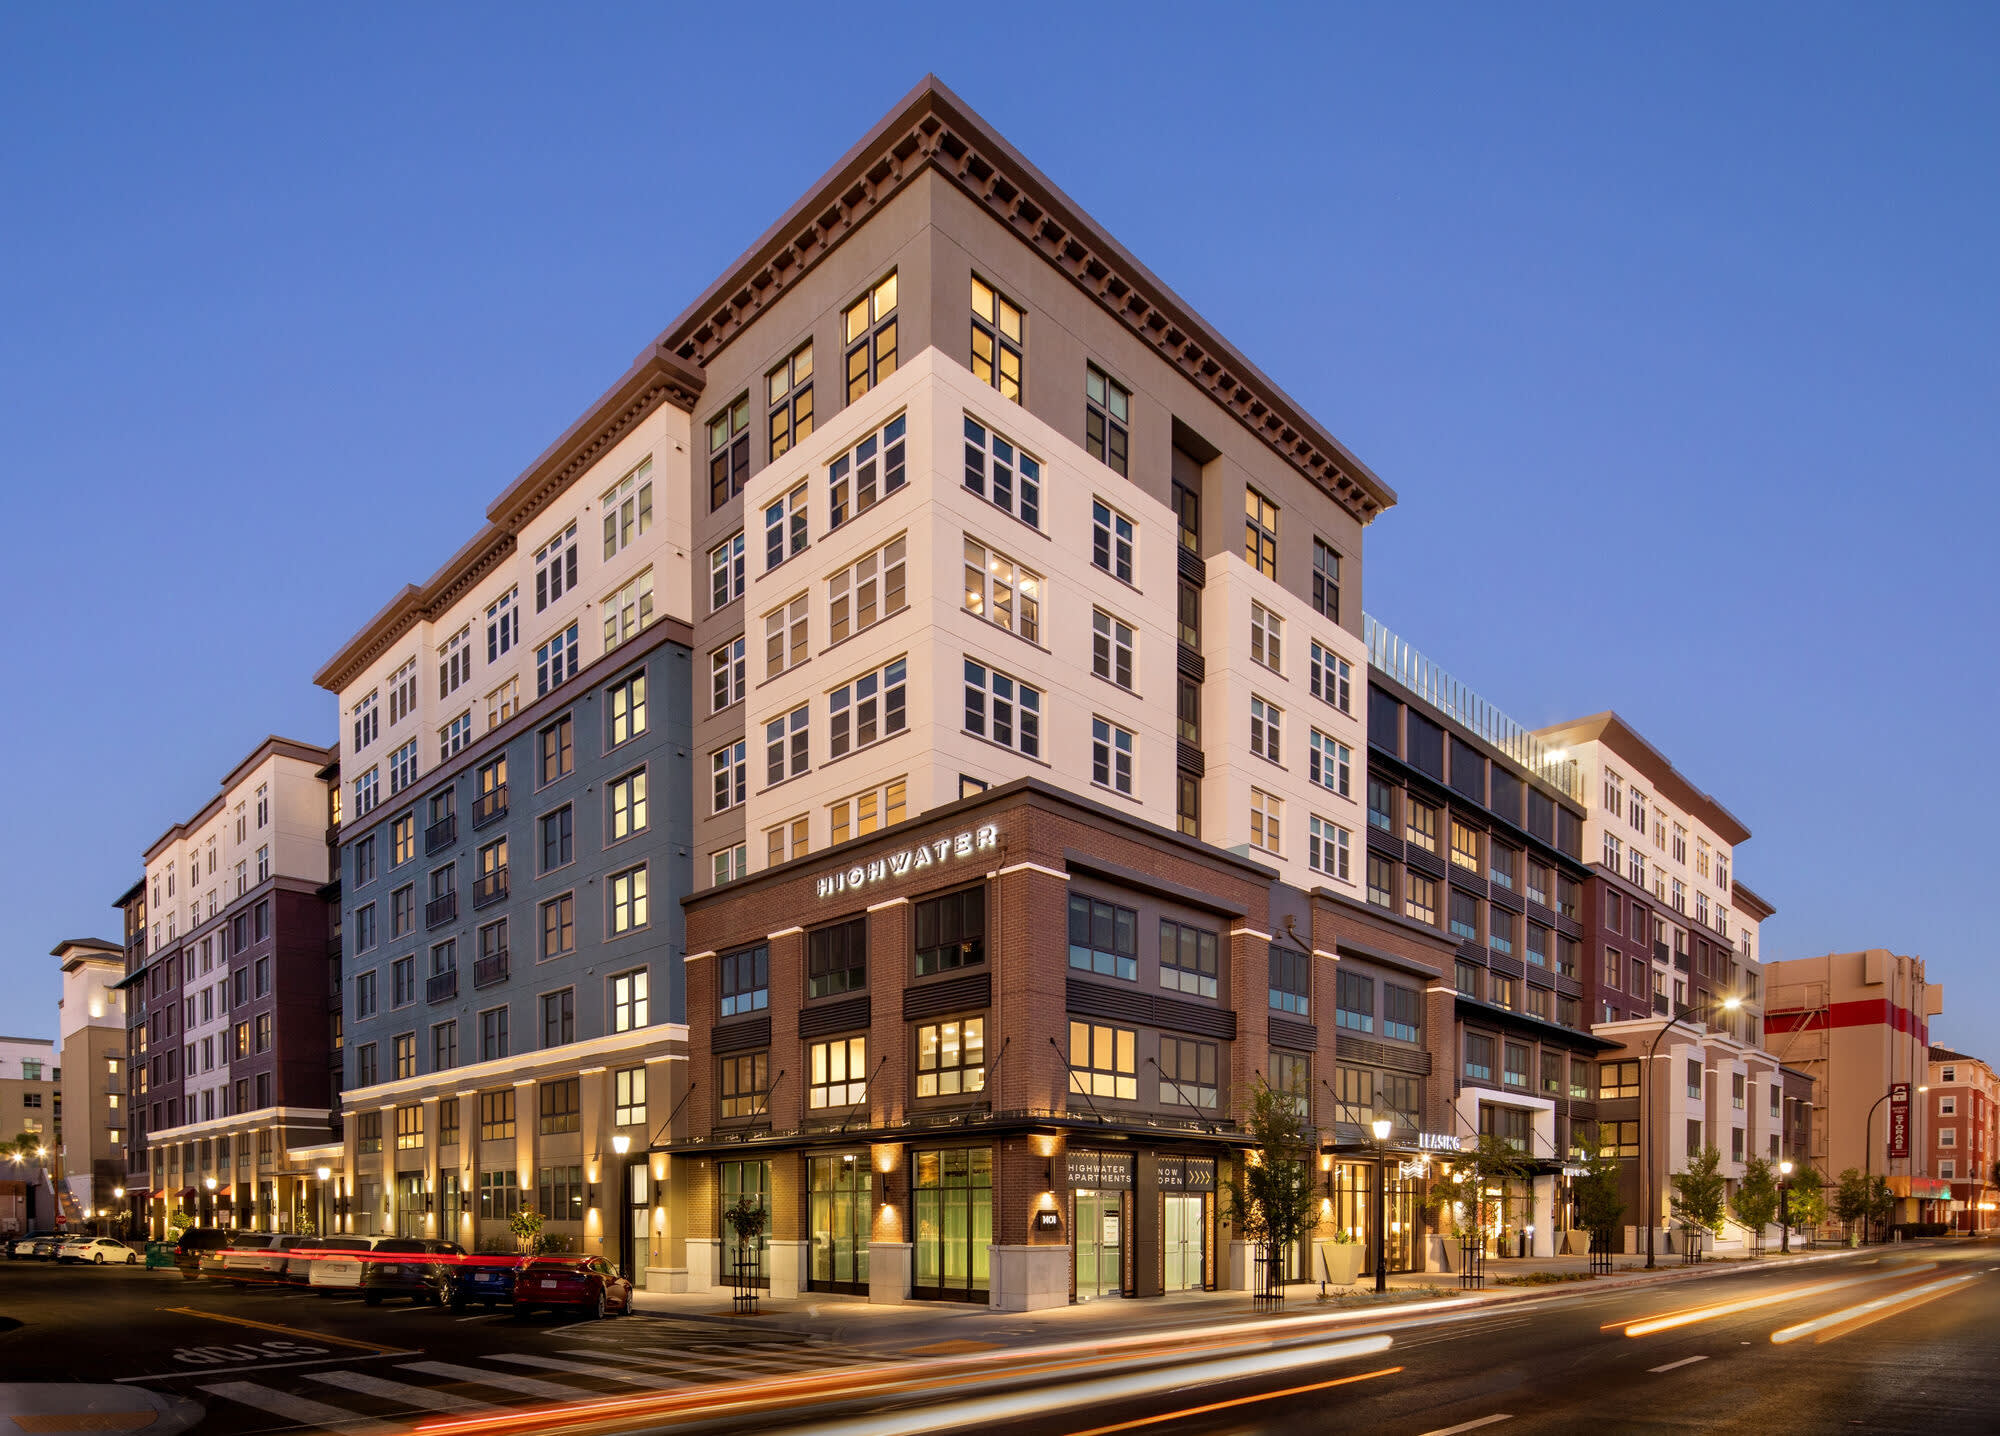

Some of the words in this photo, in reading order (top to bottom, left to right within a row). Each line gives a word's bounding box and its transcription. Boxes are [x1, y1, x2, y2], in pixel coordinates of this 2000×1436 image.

[816, 825, 998, 897] HIGHWATER
[1419, 1132, 1460, 1150] LEASING
[1068, 1164, 1125, 1173] HIGHWATER
[1158, 1168, 1178, 1176] NOW
[1068, 1173, 1132, 1183] APARTMENTS
[1158, 1177, 1183, 1185] OPEN
[173, 1341, 330, 1364] STOP
